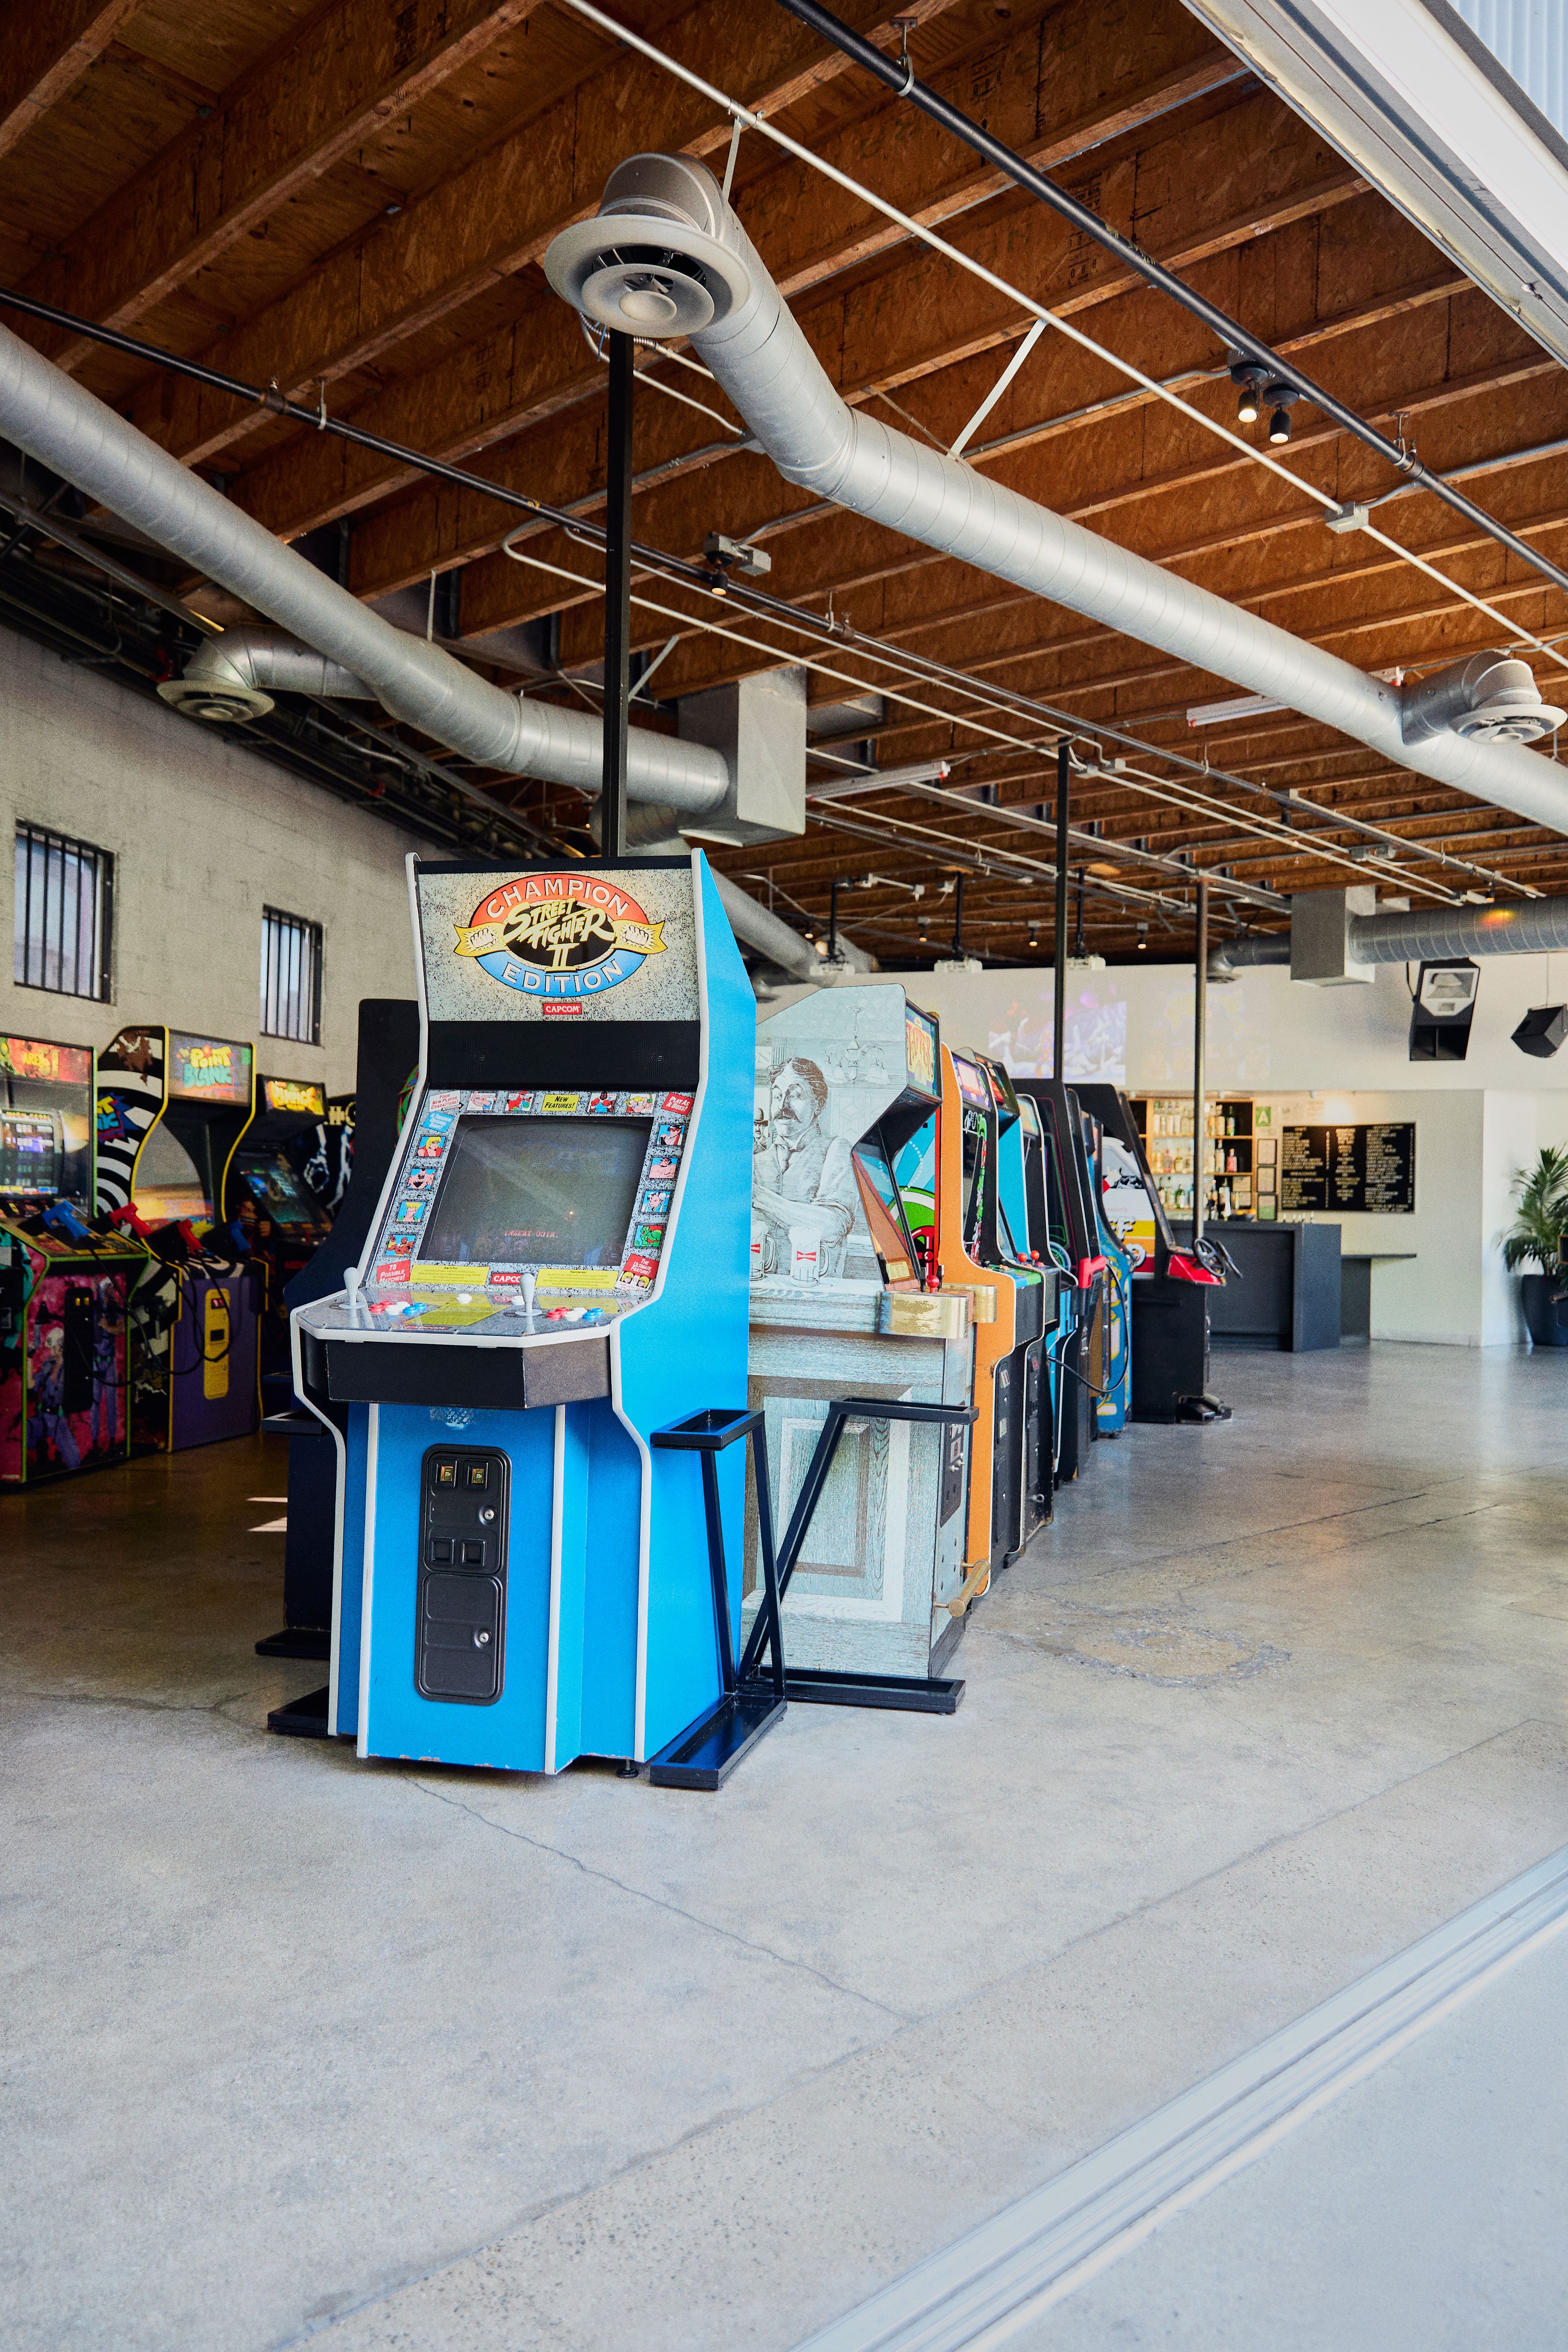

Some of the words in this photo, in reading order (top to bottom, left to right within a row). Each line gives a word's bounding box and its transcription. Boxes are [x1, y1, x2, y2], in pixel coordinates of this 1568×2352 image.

[486, 878, 631, 918] CHAMPION
[503, 897, 576, 944] STREET
[516, 907, 616, 949] FIGHTER
[545, 943, 580, 971] II
[502, 958, 624, 993] EDITION
[190, 1045, 232, 1068] POINT
[184, 1063, 232, 1089] BLANK
[431, 1099, 458, 1109] CHARACTERS!
[672, 1103, 688, 1112] BOSS!
[380, 1269, 405, 1278] POSSIBLE
[630, 1266, 651, 1275] FEATURE!
[633, 1261, 652, 1271] ULTIMATE
[380, 1274, 405, 1282] MATCHES!
